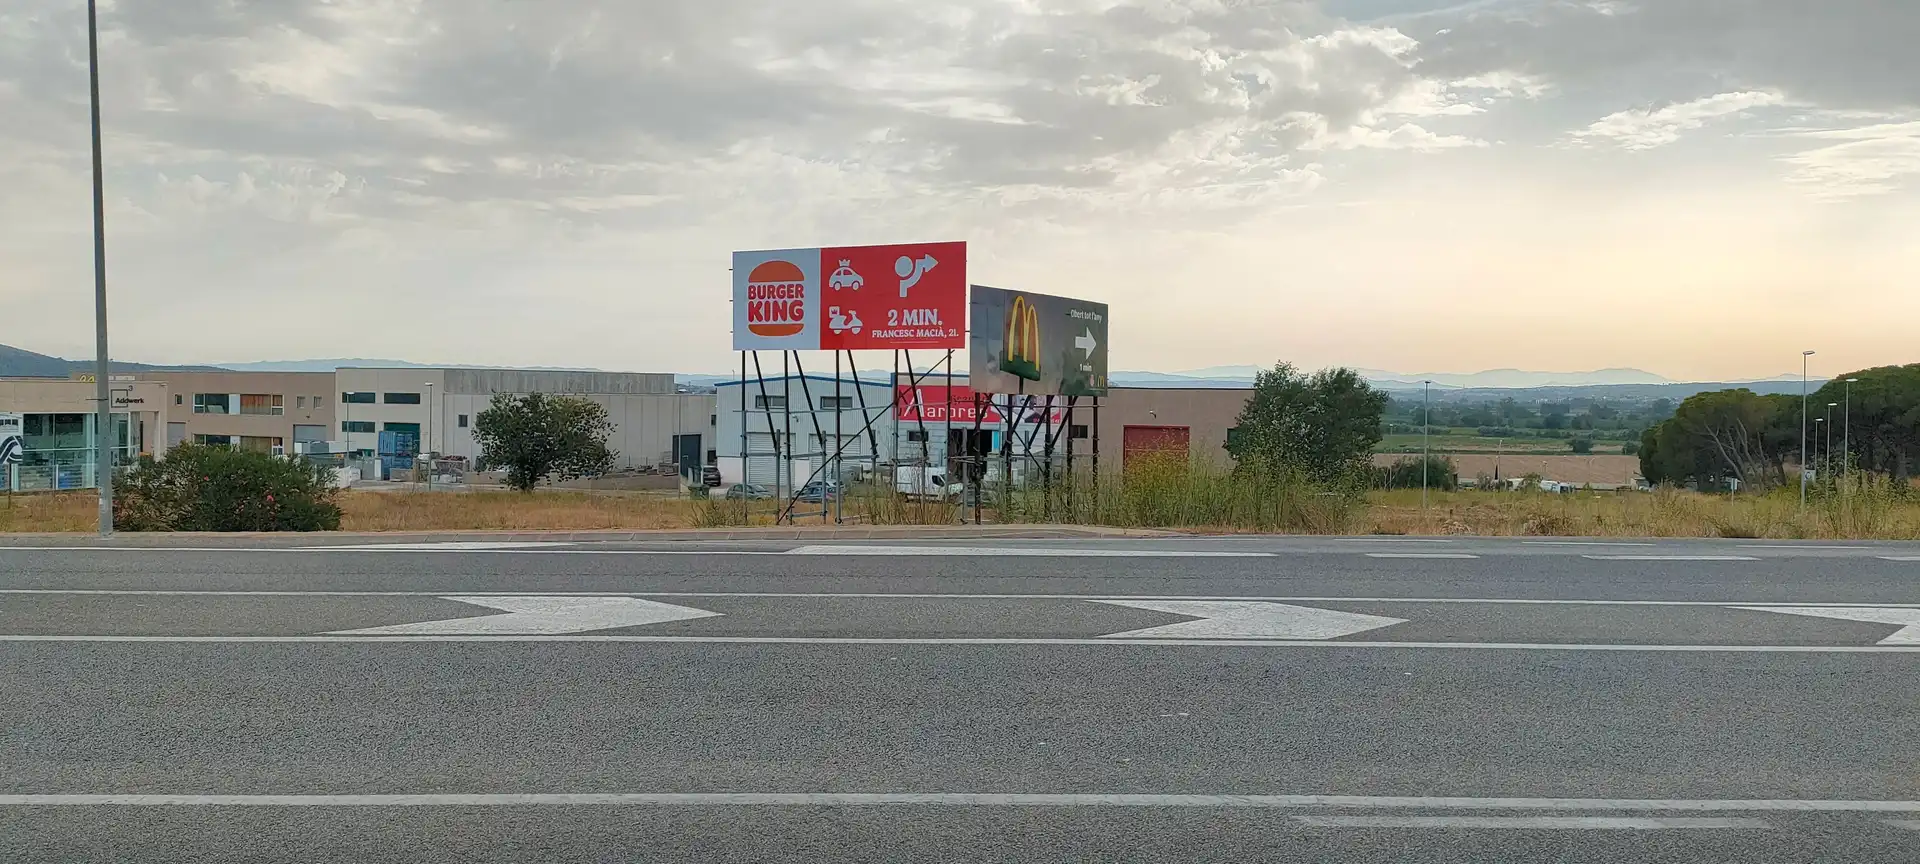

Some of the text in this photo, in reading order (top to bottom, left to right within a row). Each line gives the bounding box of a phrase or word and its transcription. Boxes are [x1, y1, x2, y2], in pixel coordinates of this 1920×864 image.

[748, 284, 804, 300] BURGER
[748, 300, 804, 322] KING
[887, 308, 943, 326] 2 MIN.
[1070, 309, 1084, 319] Obert
[871, 326, 959, 339] FRANCESC MACIÀ, 21.
[1083, 363, 1092, 372] min
